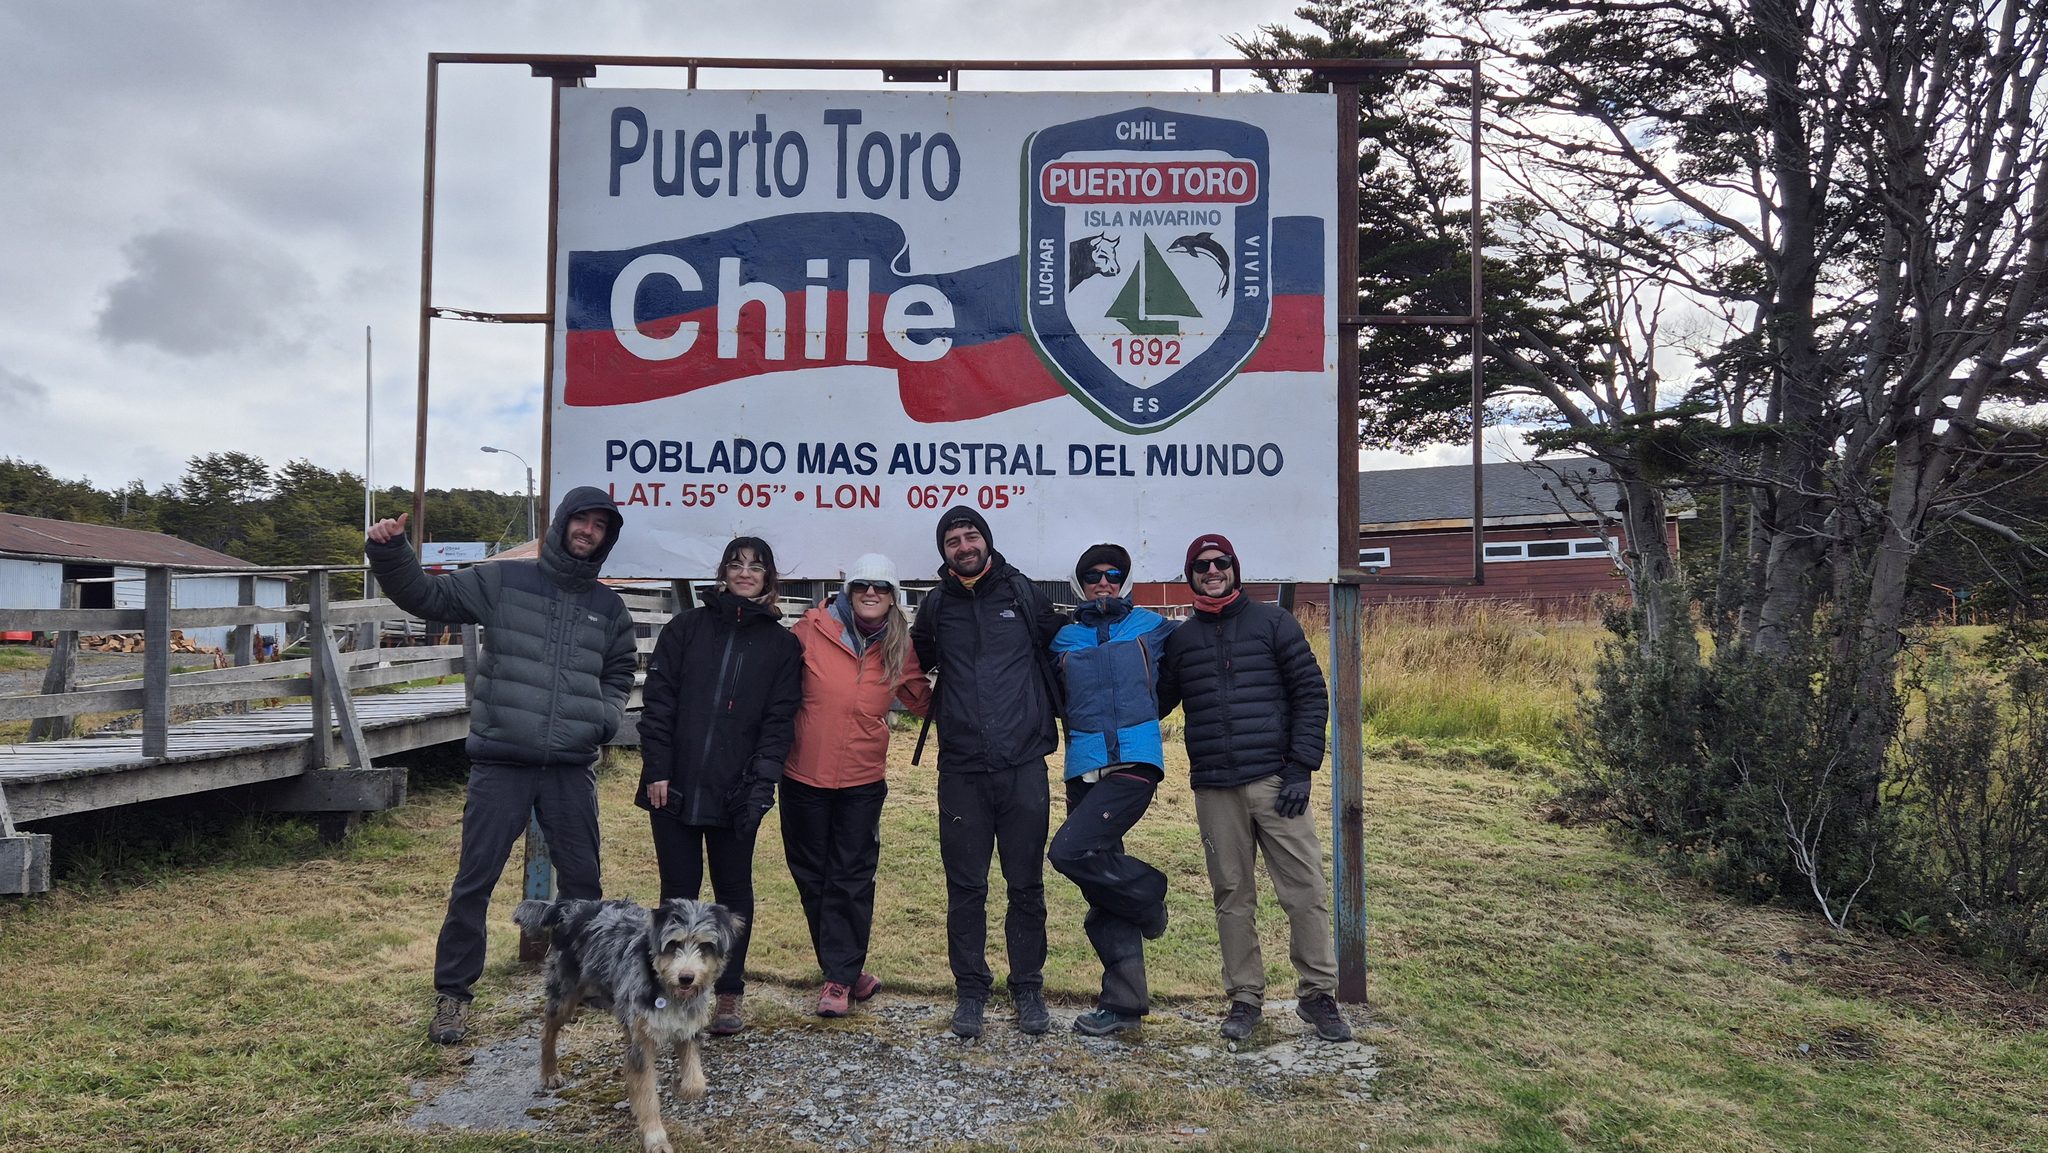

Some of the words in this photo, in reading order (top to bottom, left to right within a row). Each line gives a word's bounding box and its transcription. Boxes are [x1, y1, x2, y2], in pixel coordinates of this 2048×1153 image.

[1115, 121, 1177, 141] CHILE
[609, 106, 809, 199] Puerto
[823, 108, 961, 201] Toro
[1049, 167, 1162, 196] PUERTO
[1168, 167, 1248, 195] TORO
[1084, 210, 1124, 227] ISLA
[1129, 210, 1222, 227] NAVARINO
[1039, 238, 1054, 305] LUCHAR
[1245, 235, 1260, 297] VIVIR
[610, 253, 956, 362] Chile
[1111, 338, 1181, 366] 1892
[1132, 397, 1159, 412] ES
[606, 438, 786, 475] POBLADO
[797, 442, 878, 476] MAS
[887, 442, 1056, 476] AUSTRAL
[1068, 443, 1135, 477] DEL
[1146, 442, 1284, 477] MUNDO
[608, 482, 671, 507] LAT.
[815, 485, 880, 508] LON
